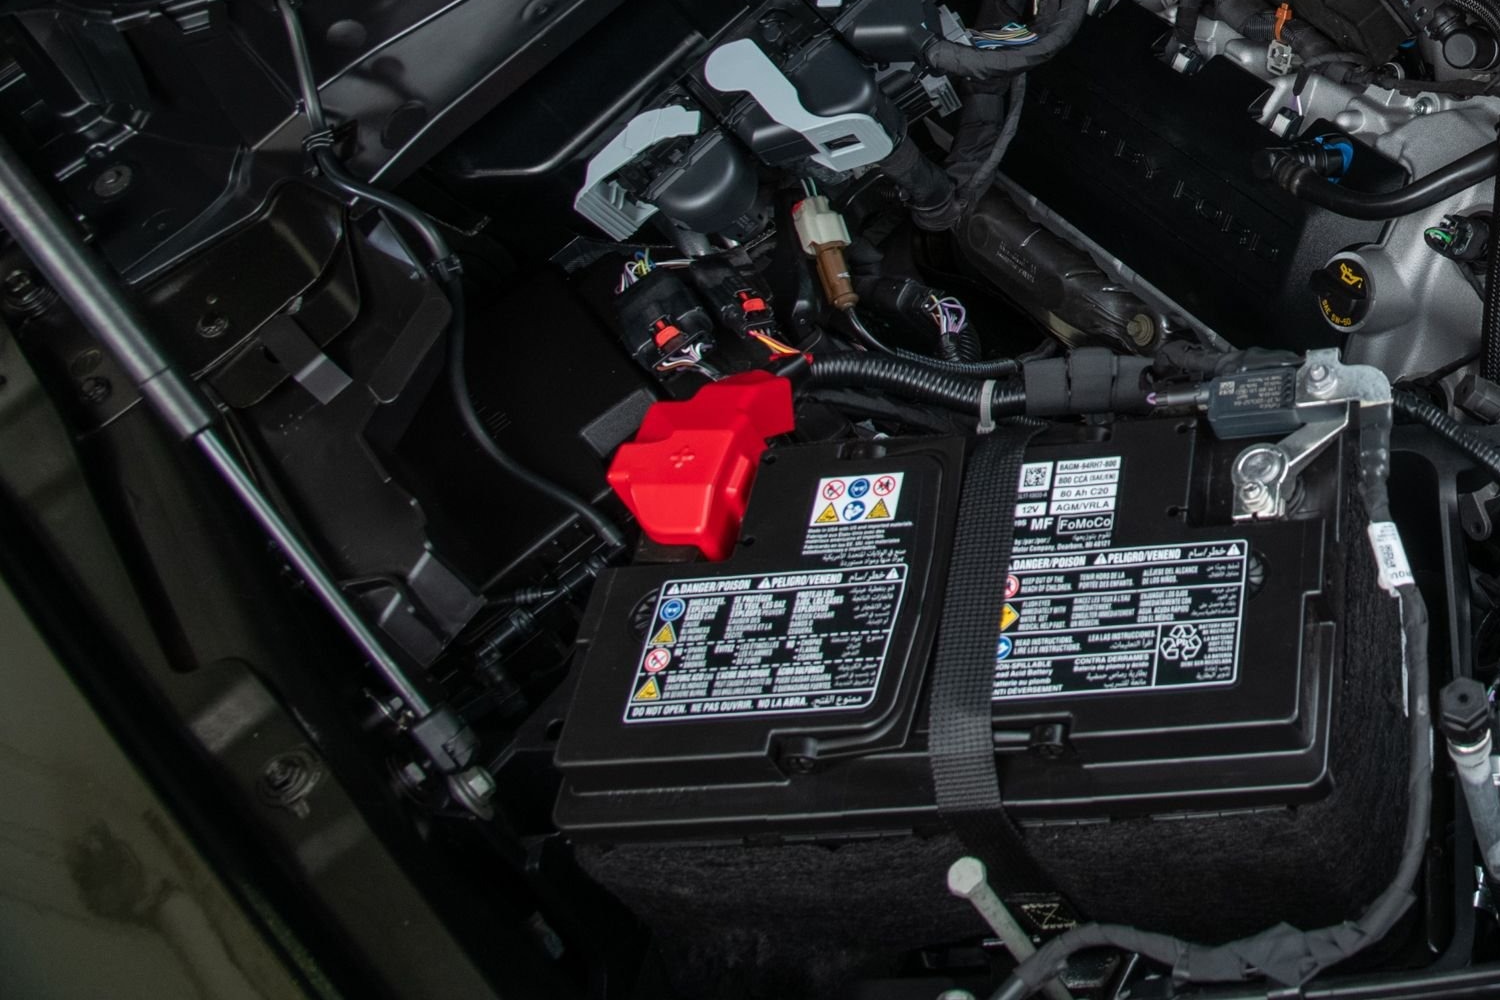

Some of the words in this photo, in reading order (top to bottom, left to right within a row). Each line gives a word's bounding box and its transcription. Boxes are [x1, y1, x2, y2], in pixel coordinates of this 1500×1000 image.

[1321, 299, 1332, 316] SAE
[1331, 313, 1352, 327] 5W-50
[1058, 475, 1072, 484] 800
[1073, 474, 1088, 483] CCA
[1060, 489, 1072, 498] 80
[1075, 488, 1088, 497] Ah
[1090, 487, 1109, 496] C20
[1022, 505, 1040, 514] 12V
[1056, 500, 1110, 512] AGM/VRLA
[1030, 517, 1054, 531] MF
[1060, 517, 1112, 531] FoMoCo
[1012, 544, 1029, 553] Motor
[1094, 539, 1111, 548] 48121
[1012, 556, 1087, 571] DANGER/POISON
[1107, 548, 1182, 564] PELIGRO/VENENO
[1110, 571, 1118, 579] DE
[1164, 566, 1175, 575] DEL
[1175, 565, 1199, 575] ALCANCE
[680, 579, 752, 591] DANGER/POISON
[771, 572, 844, 588] PELIGRO/VENENO
[1021, 577, 1035, 585] KEEP
[1035, 576, 1046, 584] OUT
[1054, 575, 1065, 583] THE
[1142, 577, 1150, 585] DE
[1149, 576, 1160, 584] LOS
[1020, 585, 1037, 593] REACH
[1045, 583, 1073, 592] CHILDREN.
[1039, 621, 1052, 629] HELP
[1015, 638, 1030, 647] READ
[1030, 635, 1075, 645] INSTRUCTIONS.
[1087, 634, 1098, 643] LEA
[1098, 633, 1110, 641] LAS
[1013, 647, 1027, 655] LIRE
[1027, 646, 1039, 654] LES
[1038, 643, 1082, 653] INSTRUCTIONS.
[1074, 656, 1107, 665] CONTRA
[1107, 654, 1150, 663] DERRAMES
[995, 660, 1053, 671] ON-SPILLABLE
[994, 671, 1010, 679] ead
[1010, 670, 1026, 678] Acid
[1026, 668, 1054, 678] Battery
[992, 679, 1018, 687] atterie
[1028, 677, 1052, 687] plomb
[1007, 683, 1064, 695] DÉVERSEMENT
[632, 707, 645, 718] DO
[645, 706, 661, 716] NOT
[663, 704, 688, 715] OPEN.
[691, 703, 702, 713] NE
[703, 702, 720, 712] PAS
[721, 700, 754, 711] OUVRIR.
[757, 699, 770, 709] NO
[771, 698, 783, 708] LA
[783, 697, 809, 708] ABRA.
